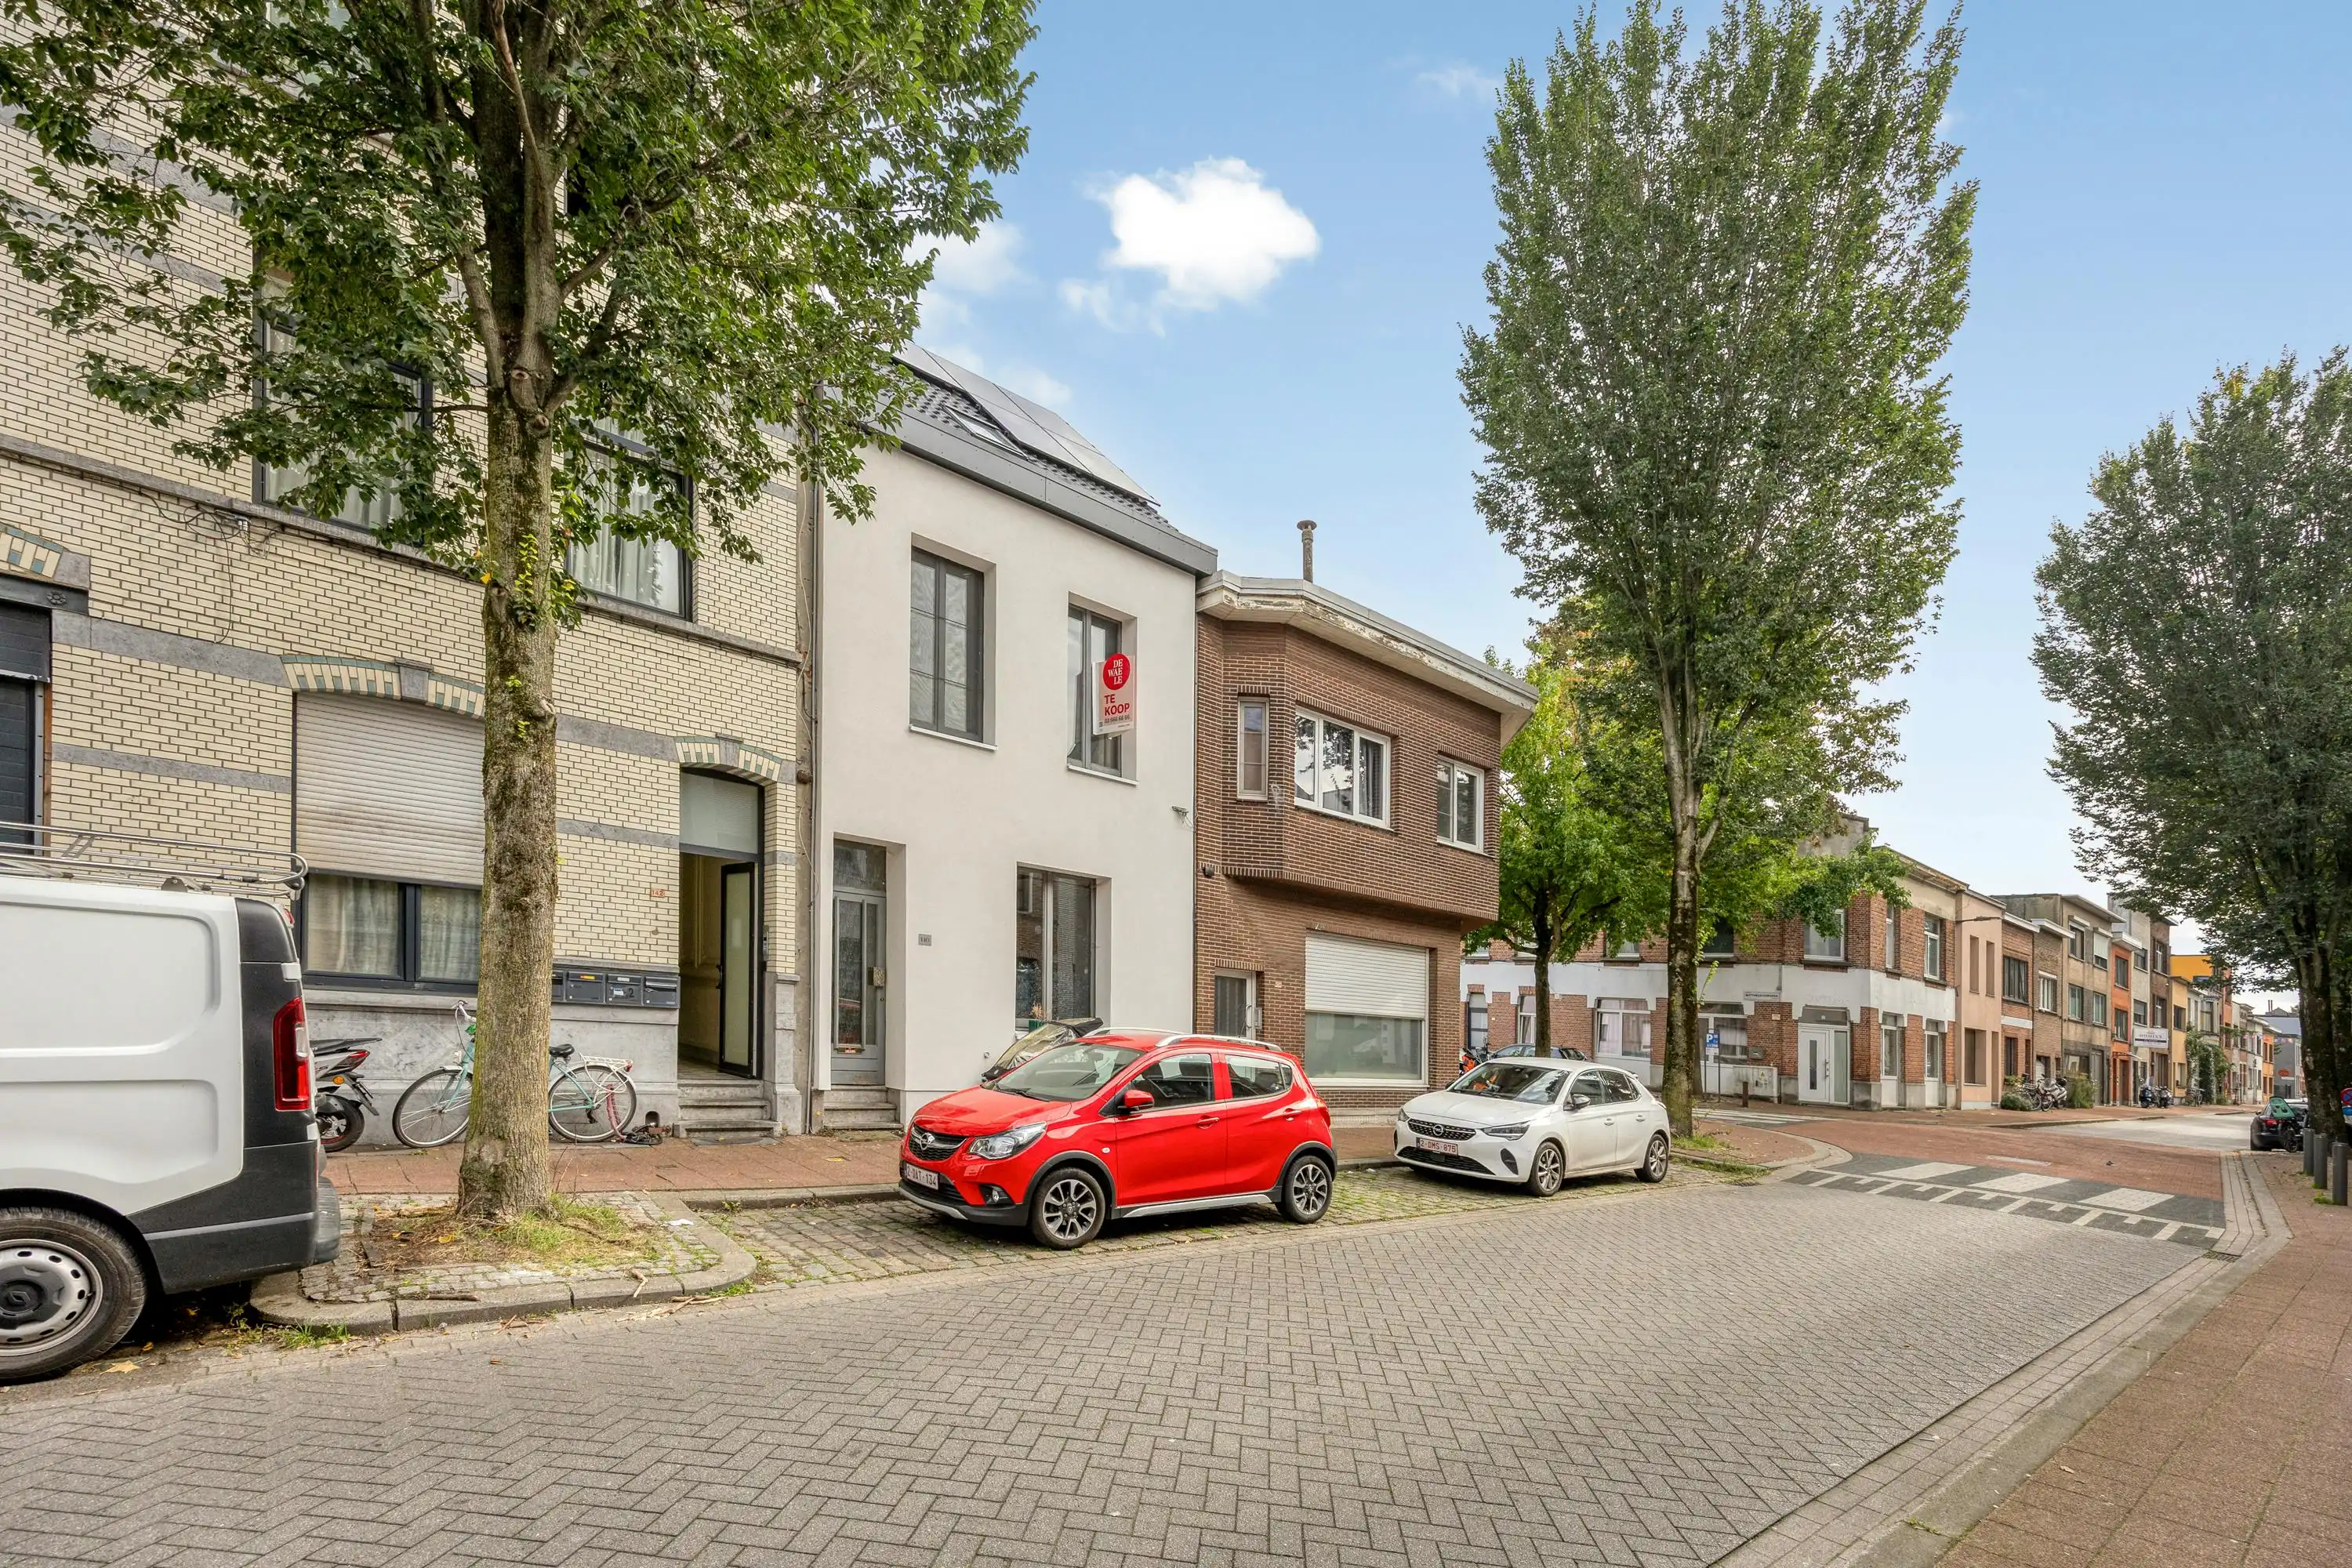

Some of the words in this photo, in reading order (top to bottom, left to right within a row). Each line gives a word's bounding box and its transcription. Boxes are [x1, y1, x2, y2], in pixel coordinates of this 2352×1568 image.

[1113, 659, 1123, 668] DE
[1108, 666, 1123, 677] WAE
[1113, 676, 1123, 685] LE
[1105, 694, 1115, 704] TE
[1105, 703, 1130, 716] KOOP
[629, 988, 634, 997] 2
[1420, 1139, 1456, 1153] 2-DMS-875
